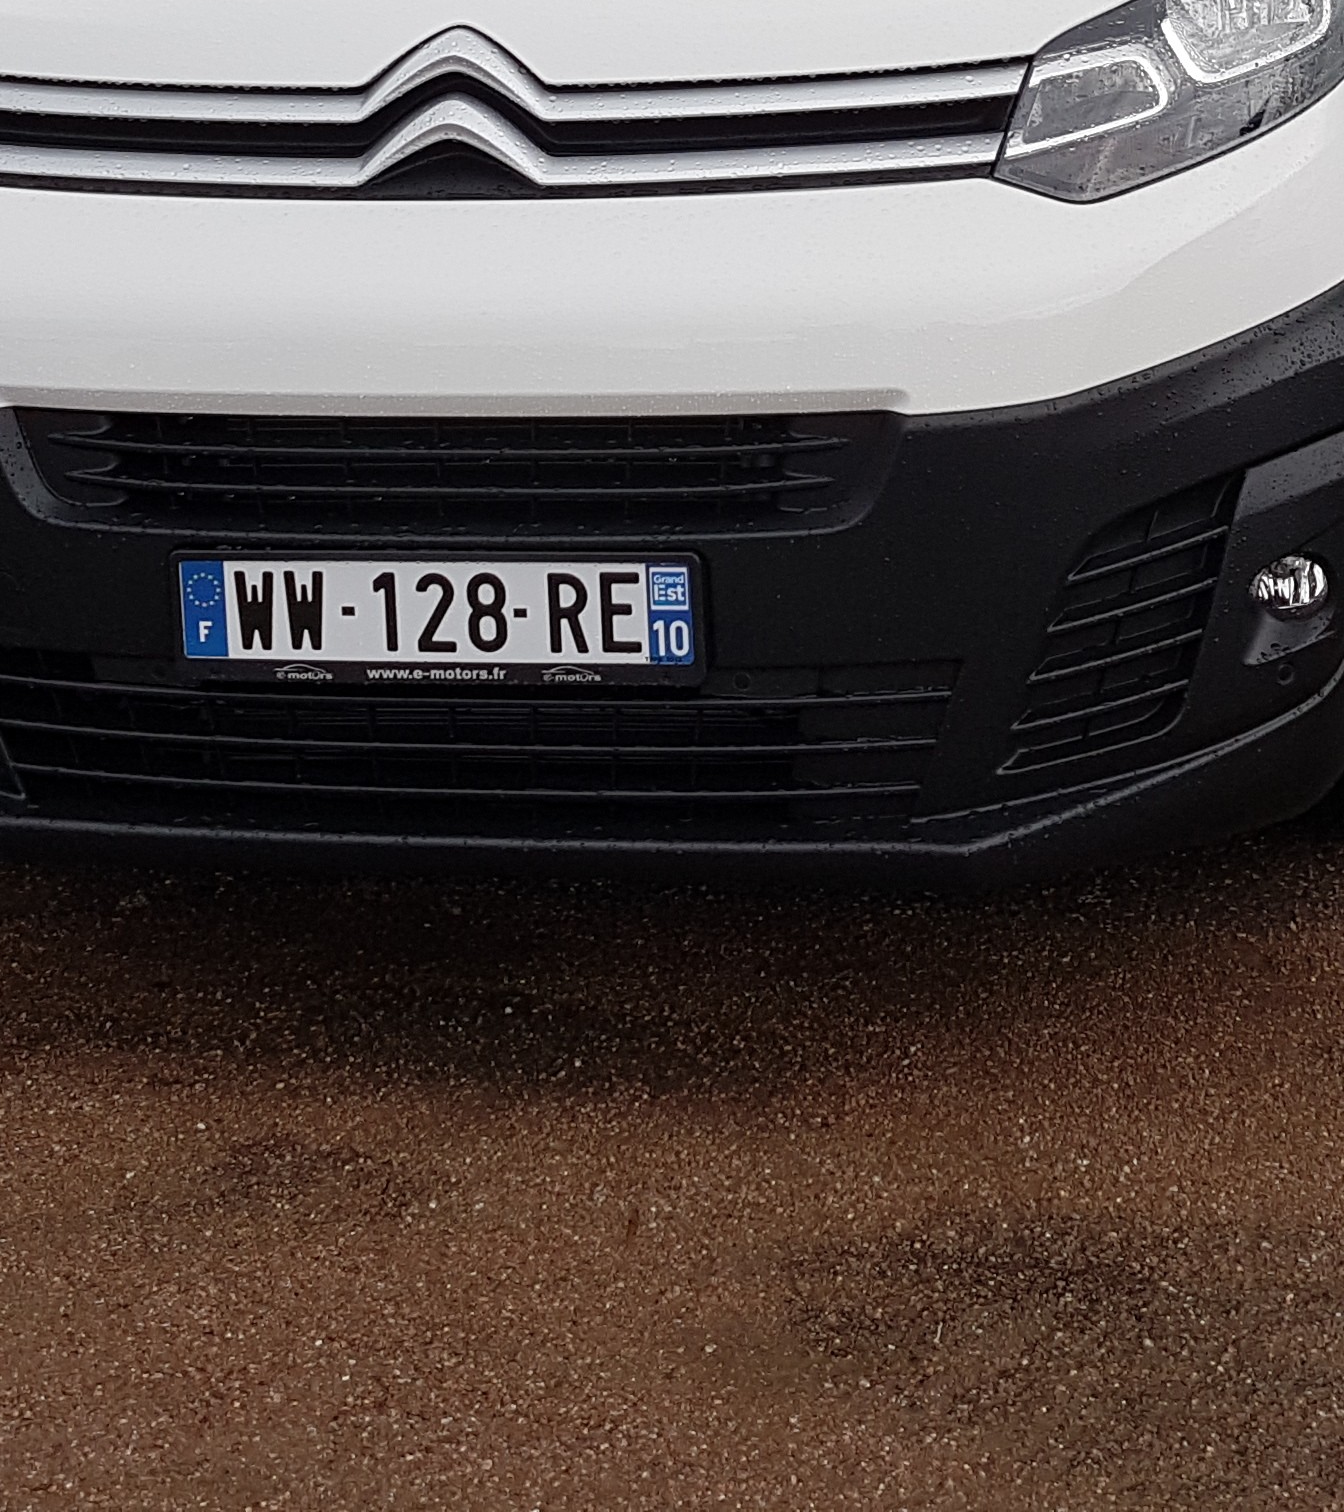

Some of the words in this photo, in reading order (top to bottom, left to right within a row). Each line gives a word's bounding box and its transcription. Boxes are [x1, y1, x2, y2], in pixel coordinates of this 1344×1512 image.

[653, 574, 685, 585] Grand
[653, 584, 685, 601] Est
[198, 620, 213, 643] F
[652, 619, 690, 657] 10
[366, 666, 507, 681] www.e-motors.fr
